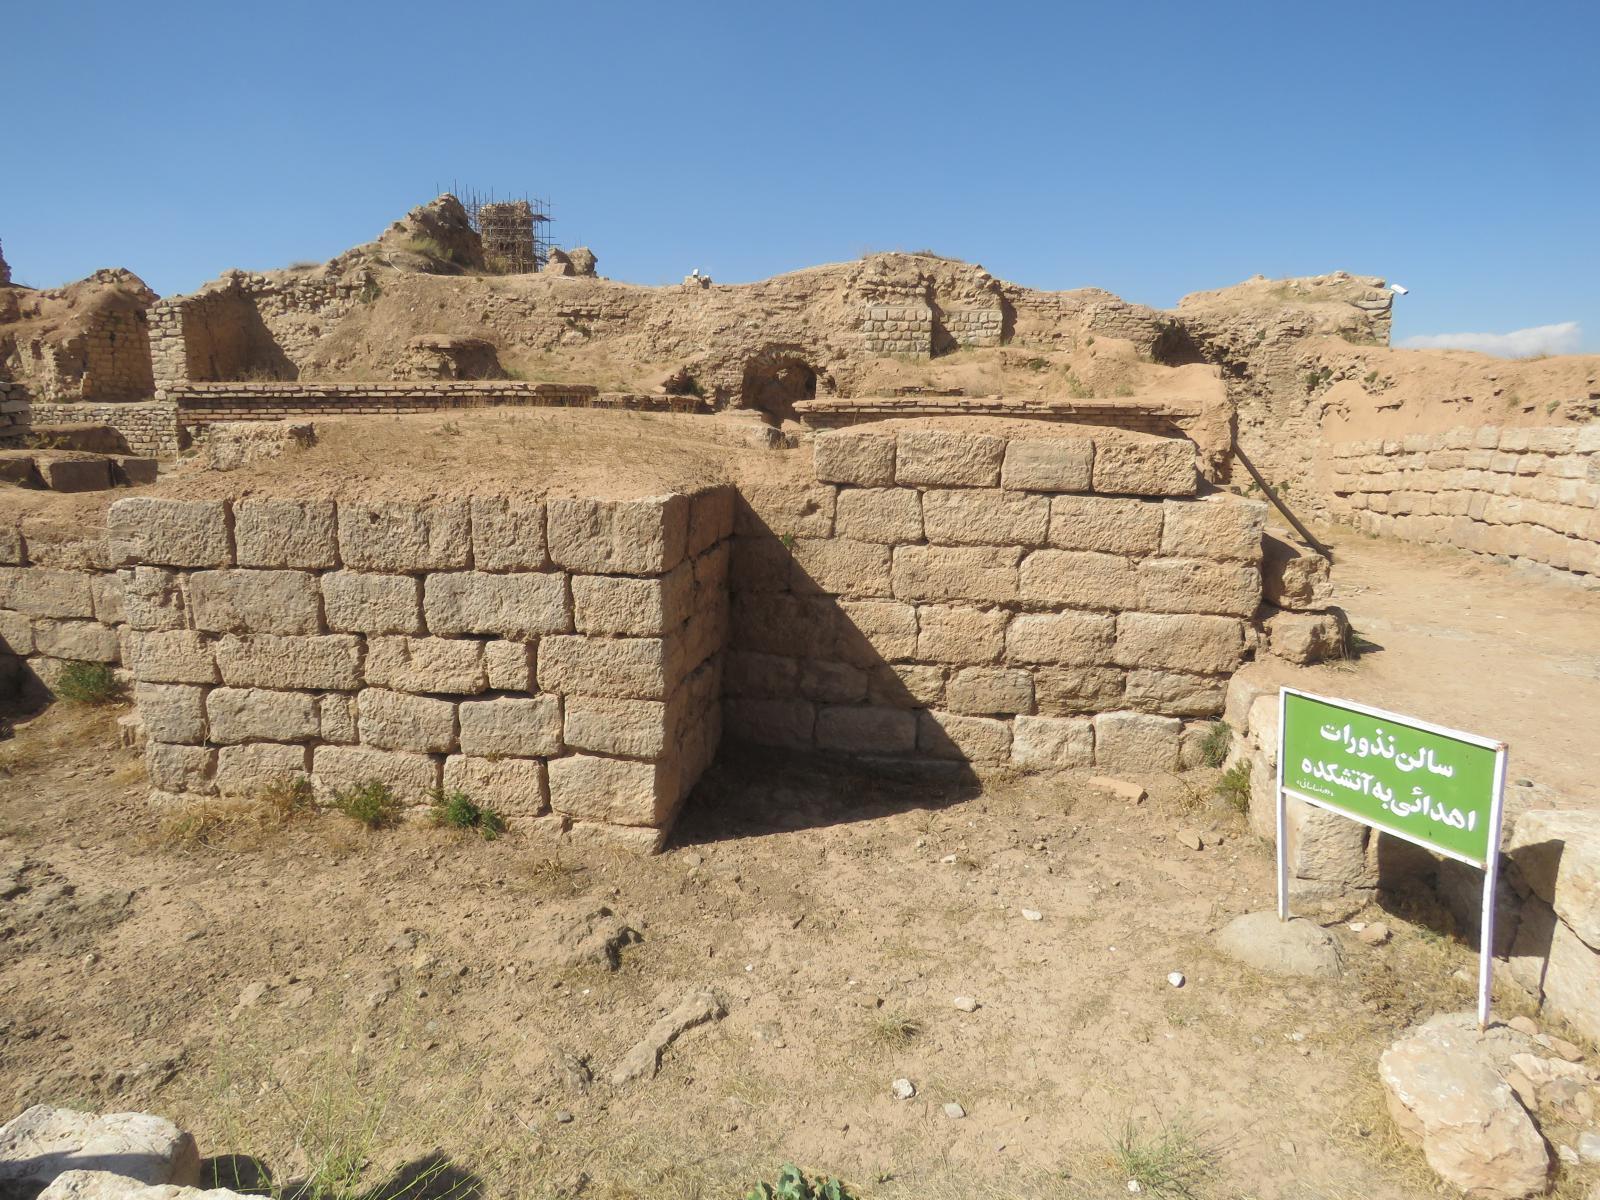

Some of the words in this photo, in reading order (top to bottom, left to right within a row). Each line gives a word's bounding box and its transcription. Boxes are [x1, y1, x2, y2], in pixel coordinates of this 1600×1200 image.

[1320, 723, 1395, 759] نذورات
[1301, 757, 1374, 795] آتشکده
[1395, 747, 1454, 777] سالن
[1372, 781, 1393, 810] به
